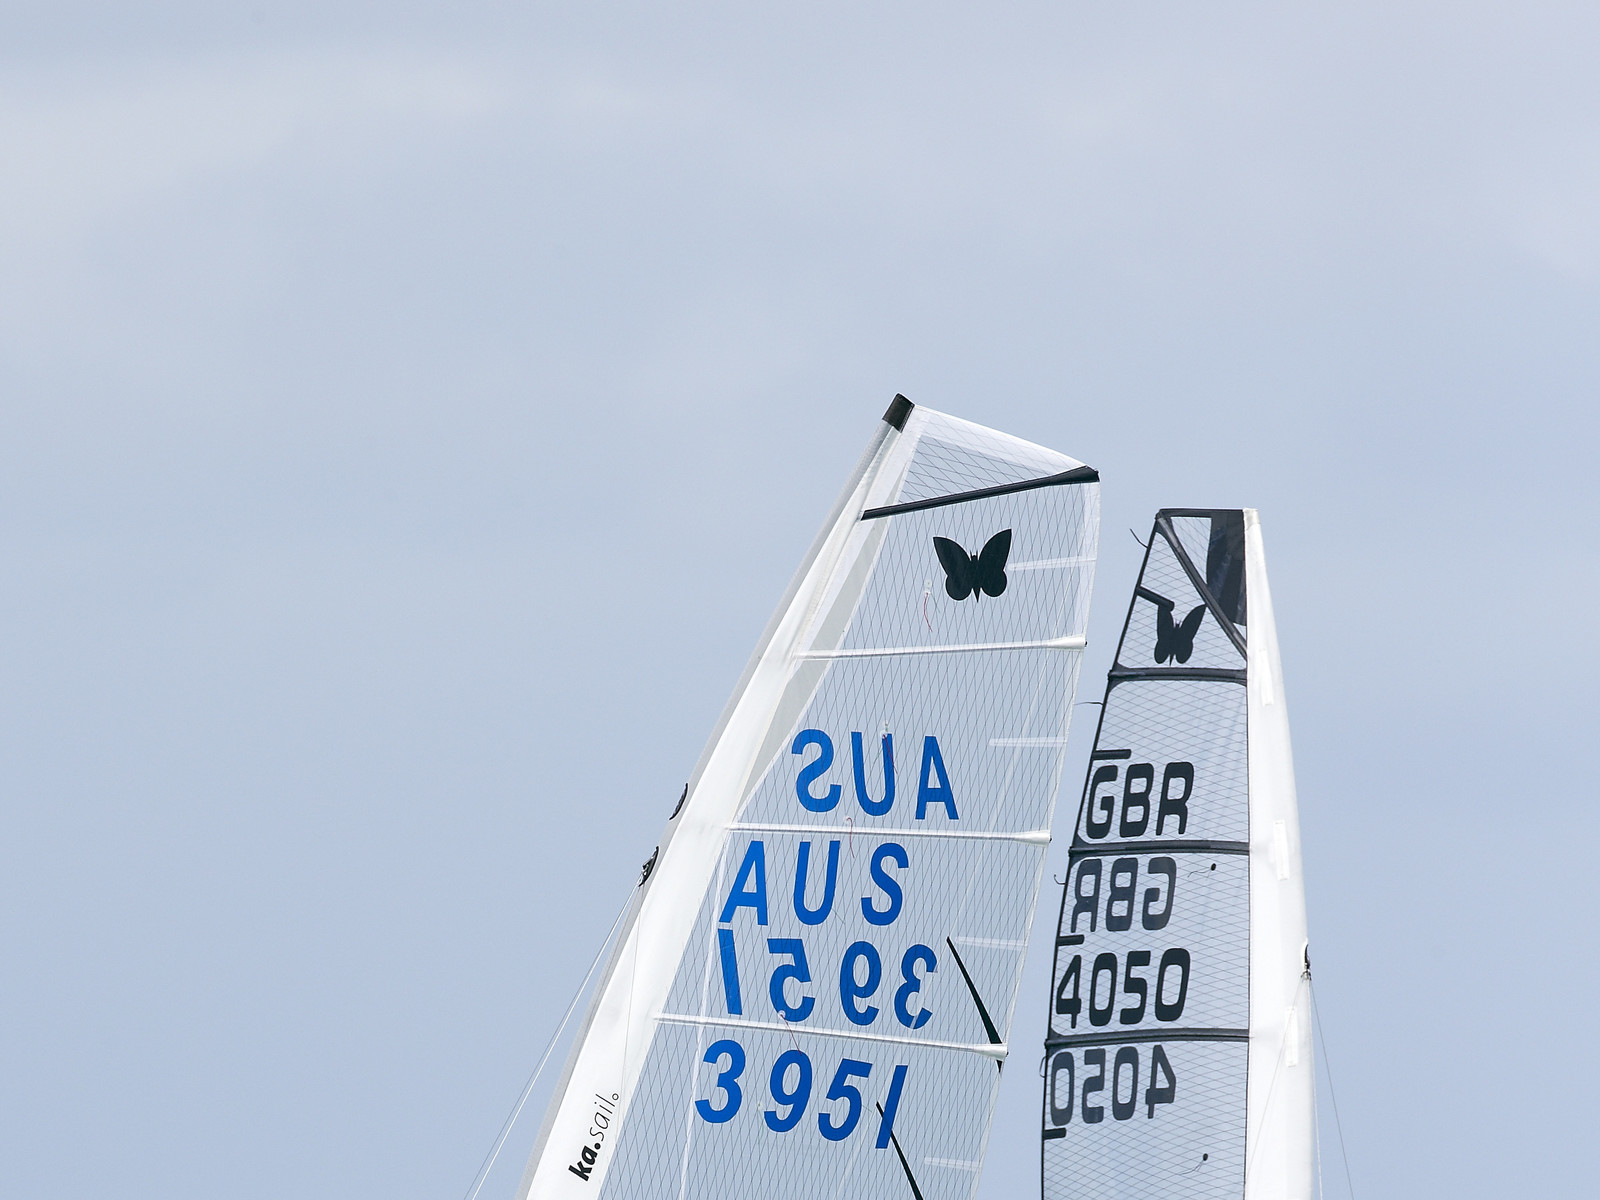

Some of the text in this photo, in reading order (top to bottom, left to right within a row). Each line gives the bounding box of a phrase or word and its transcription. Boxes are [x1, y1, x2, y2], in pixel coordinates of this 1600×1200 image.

[1085, 760, 1195, 840] GBR
[719, 839, 909, 926] AUS
[1054, 947, 1191, 1029] 4050
[694, 1039, 909, 1150] 3951
